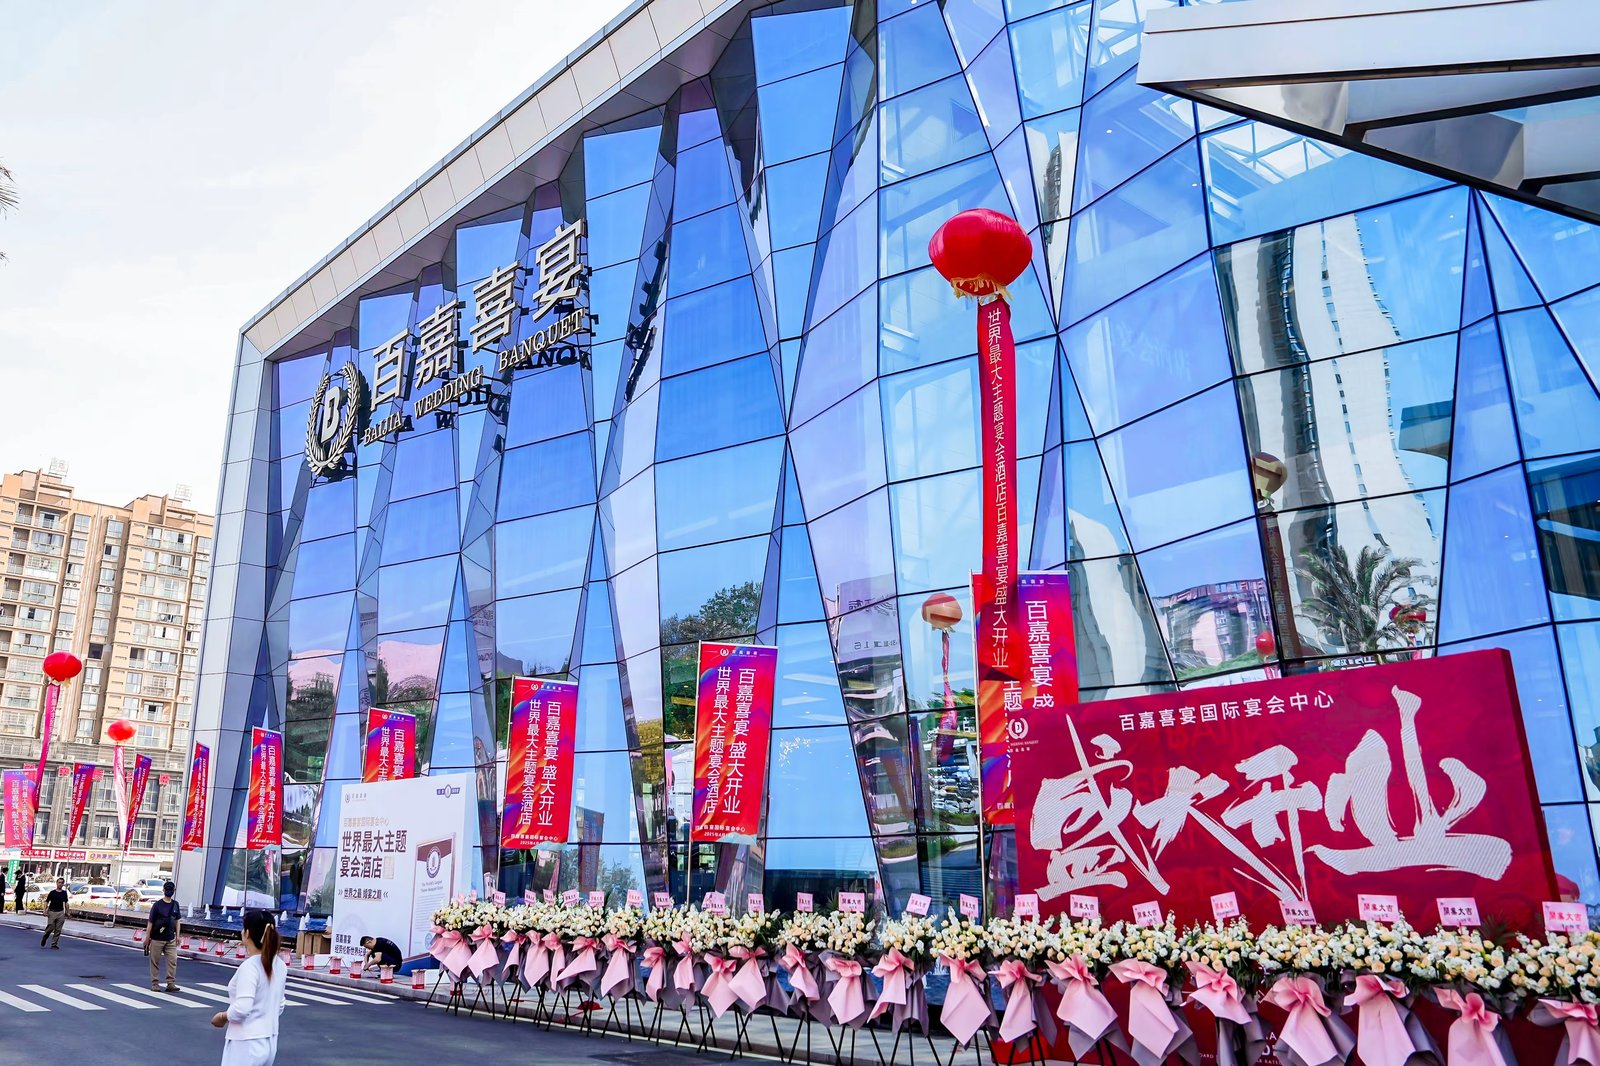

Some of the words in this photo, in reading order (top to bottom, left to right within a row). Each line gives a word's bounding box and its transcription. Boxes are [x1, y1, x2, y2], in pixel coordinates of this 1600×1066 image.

[371, 218, 585, 411] 百嘉喜宴
[364, 411, 402, 447] BAIJIA
[414, 366, 483, 421] WEDDING
[498, 309, 585, 373] BANQUET
[1025, 600, 1053, 687] 百嘉喜宴
[543, 701, 562, 761] 百嘉喜宴
[732, 668, 756, 737] 百嘉喜宴
[1119, 690, 1335, 732] 百嘉喜宴国际宴会中心
[518, 699, 541, 825] 世界最大主题宴会酒店
[703, 666, 732, 814] 世界最大主题宴会酒店
[537, 764, 557, 826] 盛大开业
[722, 741, 747, 814] 盛大开业
[1030, 685, 1512, 901] 盛大开业
[340, 856, 383, 879] 宴会酒店
[342, 829, 407, 854] 世界最大主题
